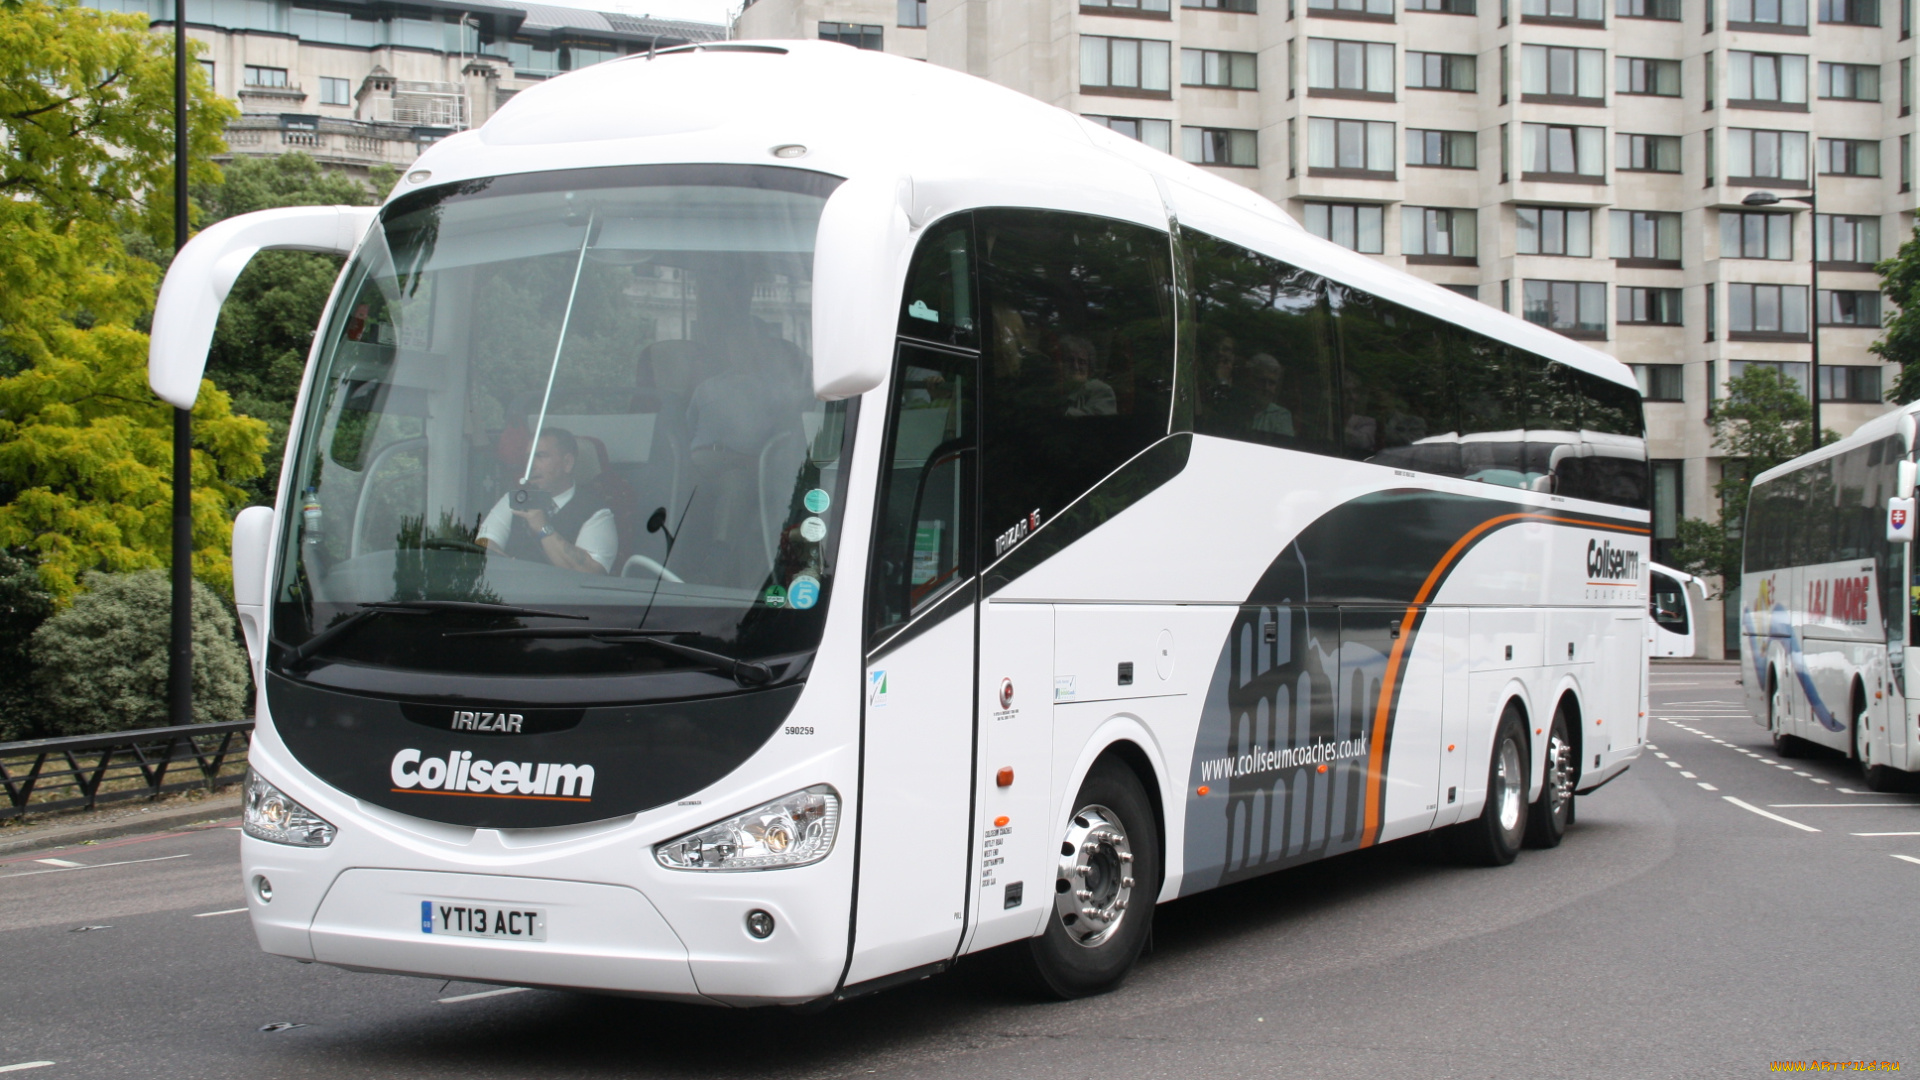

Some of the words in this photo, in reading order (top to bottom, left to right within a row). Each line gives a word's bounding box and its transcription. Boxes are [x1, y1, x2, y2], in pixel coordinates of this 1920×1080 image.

[995, 518, 1028, 557] IRIZAR
[1587, 538, 1639, 580] Coliseum
[797, 589, 813, 609] 5
[1832, 575, 1870, 624] MORE
[451, 710, 524, 734] IRIZAR
[784, 726, 815, 736] 590259
[390, 748, 595, 797] Coliseum
[1201, 730, 1368, 782] www.coliseumcoaches.co.uk
[439, 906, 487, 933] YT13
[494, 910, 538, 936] ACT
